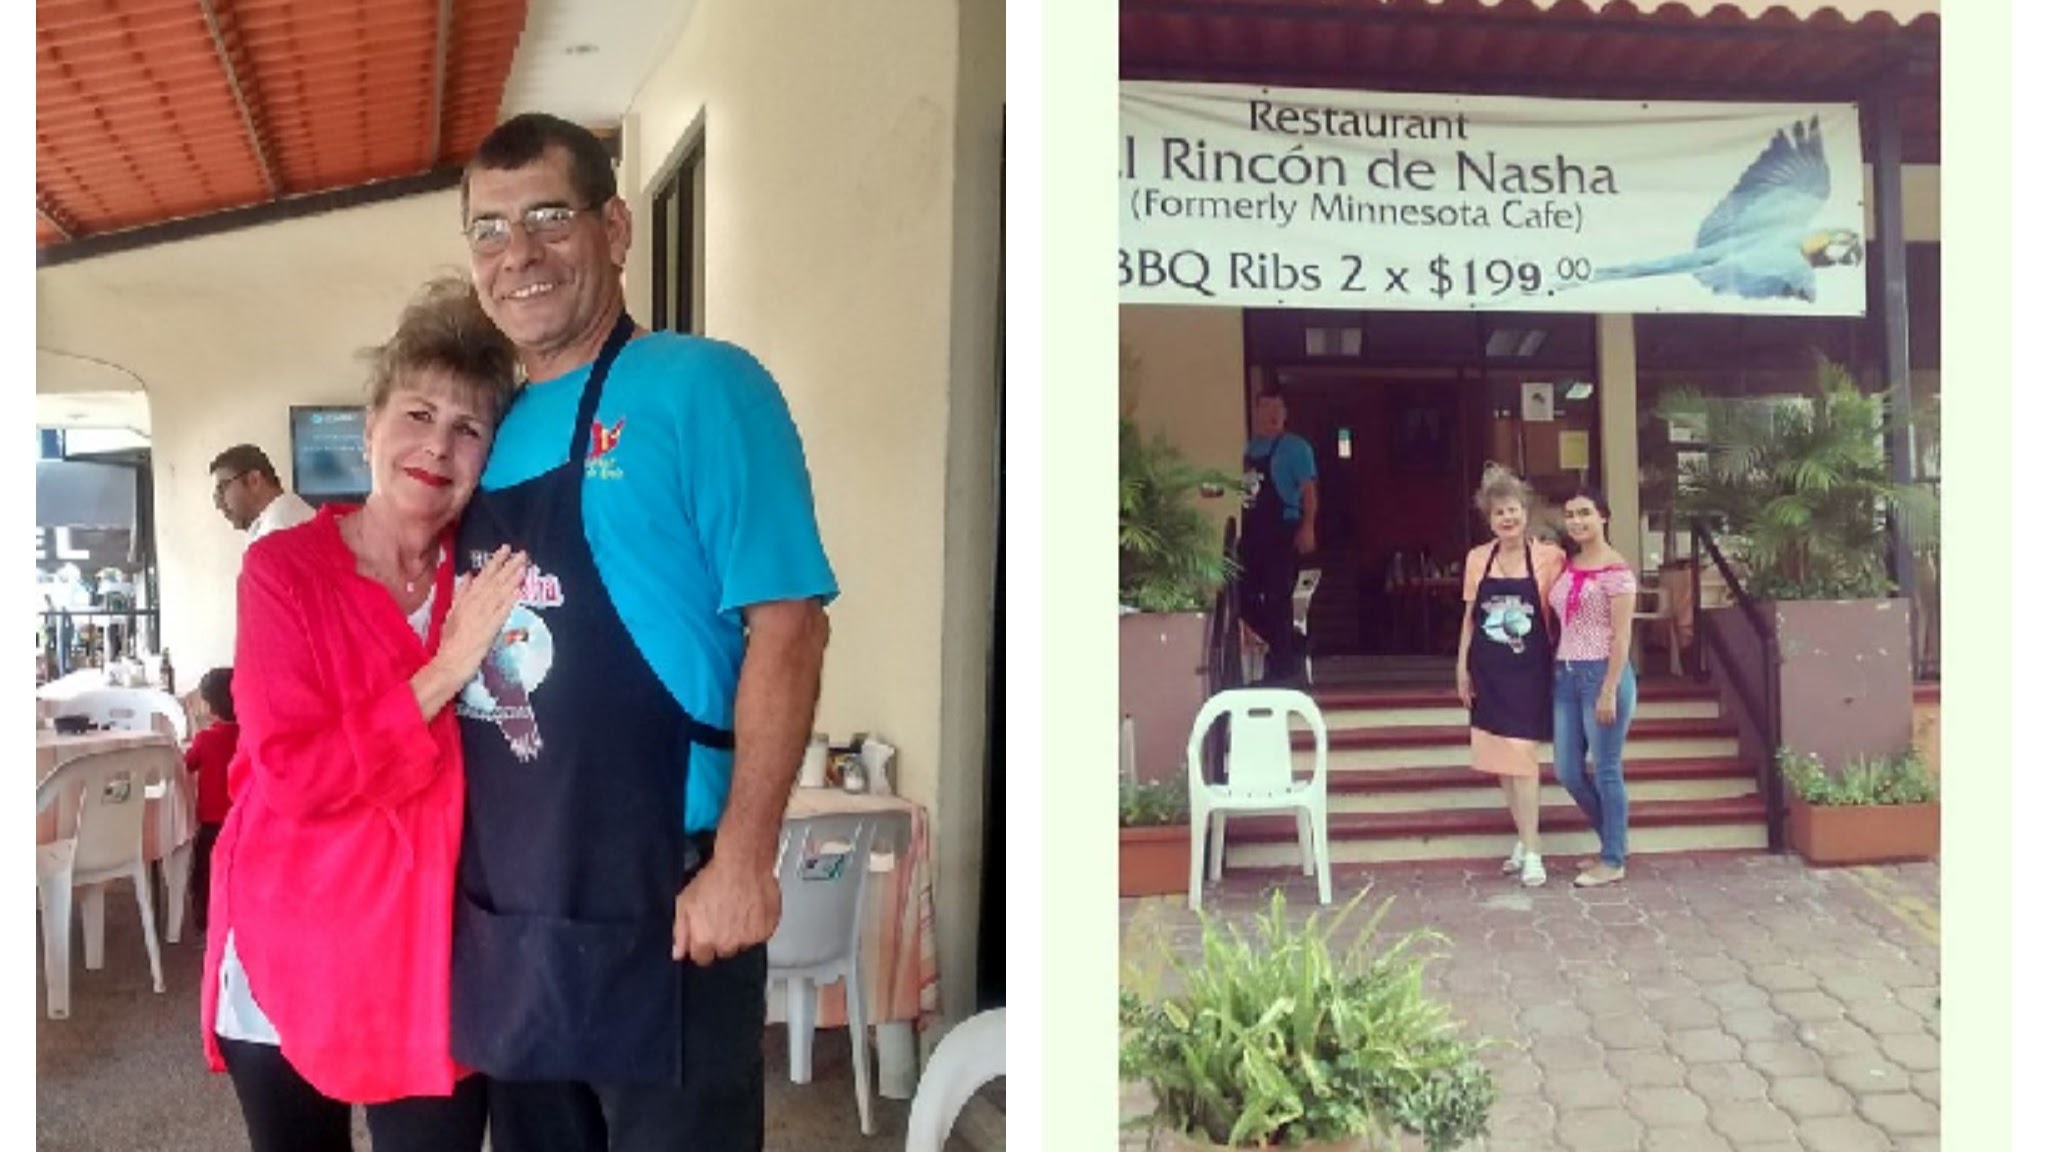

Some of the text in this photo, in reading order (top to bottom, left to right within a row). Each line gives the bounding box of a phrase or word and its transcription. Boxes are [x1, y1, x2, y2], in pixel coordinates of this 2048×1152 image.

[1250, 100, 1469, 140] Restaurant
[1162, 137, 1347, 186] Rincón
[1367, 148, 1436, 191] de
[1456, 150, 1619, 194] Nasha
[1131, 188, 1583, 233] (Formerly Minnesota Cafe)
[1229, 252, 1322, 291] Ribs
[1340, 254, 1367, 292] 2
[1384, 267, 1410, 293] x
